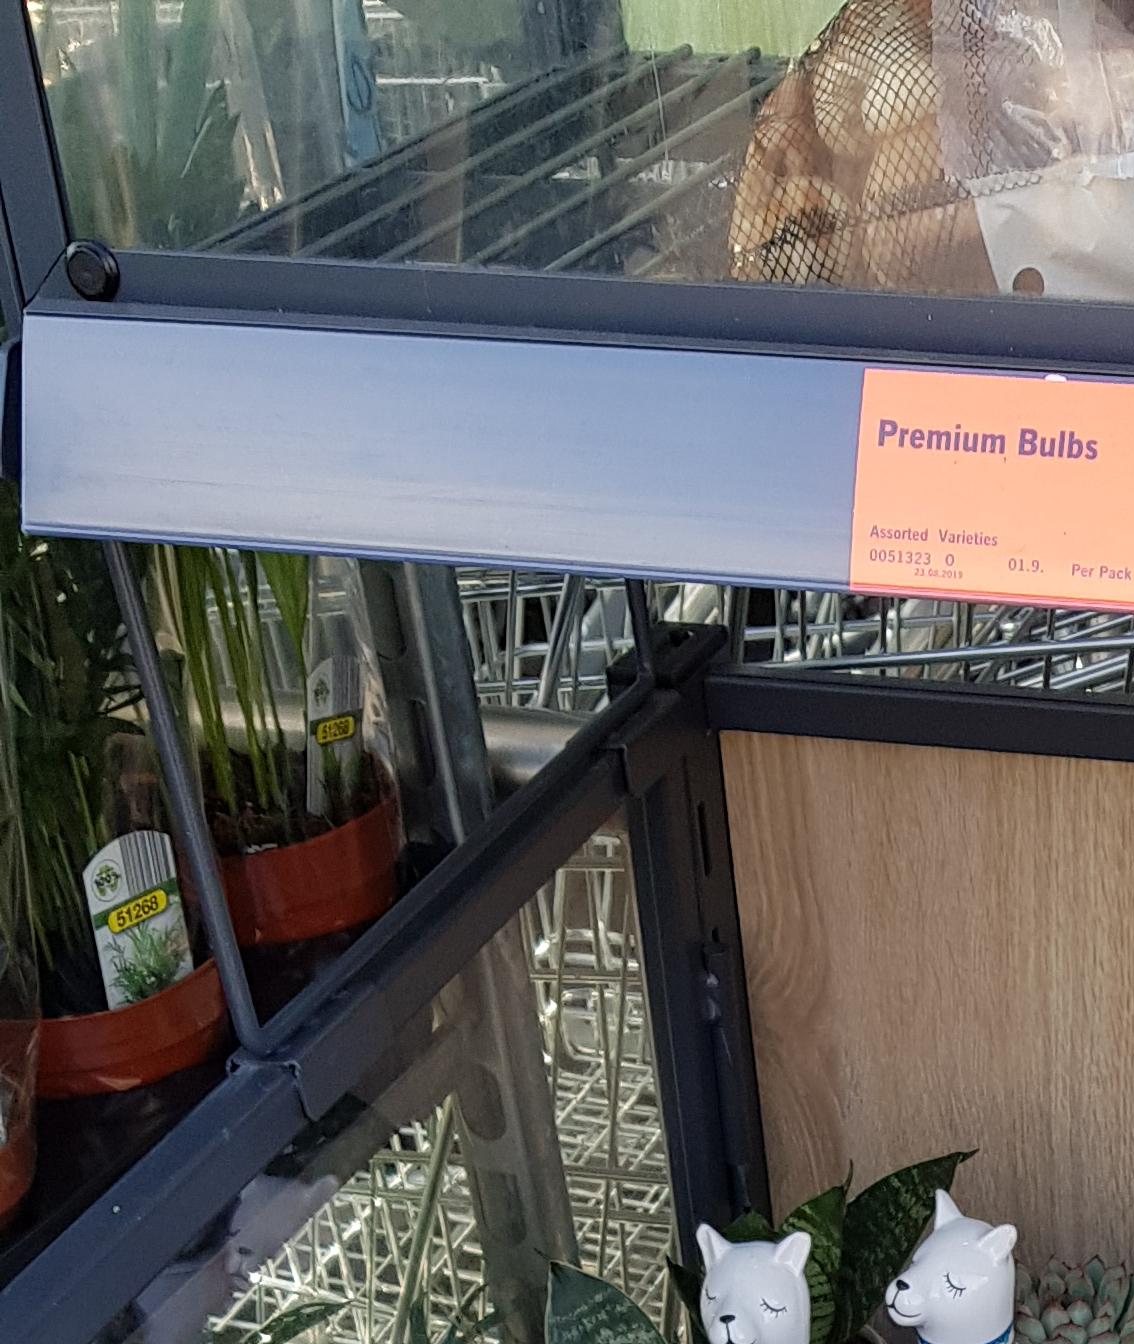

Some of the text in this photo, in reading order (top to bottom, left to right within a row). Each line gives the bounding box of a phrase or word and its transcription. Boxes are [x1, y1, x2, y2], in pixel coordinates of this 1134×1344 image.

[877, 418, 1099, 461] Premium Bulbs
[869, 524, 998, 547] Assorted Varieties
[869, 548, 932, 566] 0051323
[1008, 558, 1044, 574] 01.9.
[1071, 564, 1094, 578] Per
[1099, 565, 1132, 581] Pack
[116, 895, 159, 928] 51268
